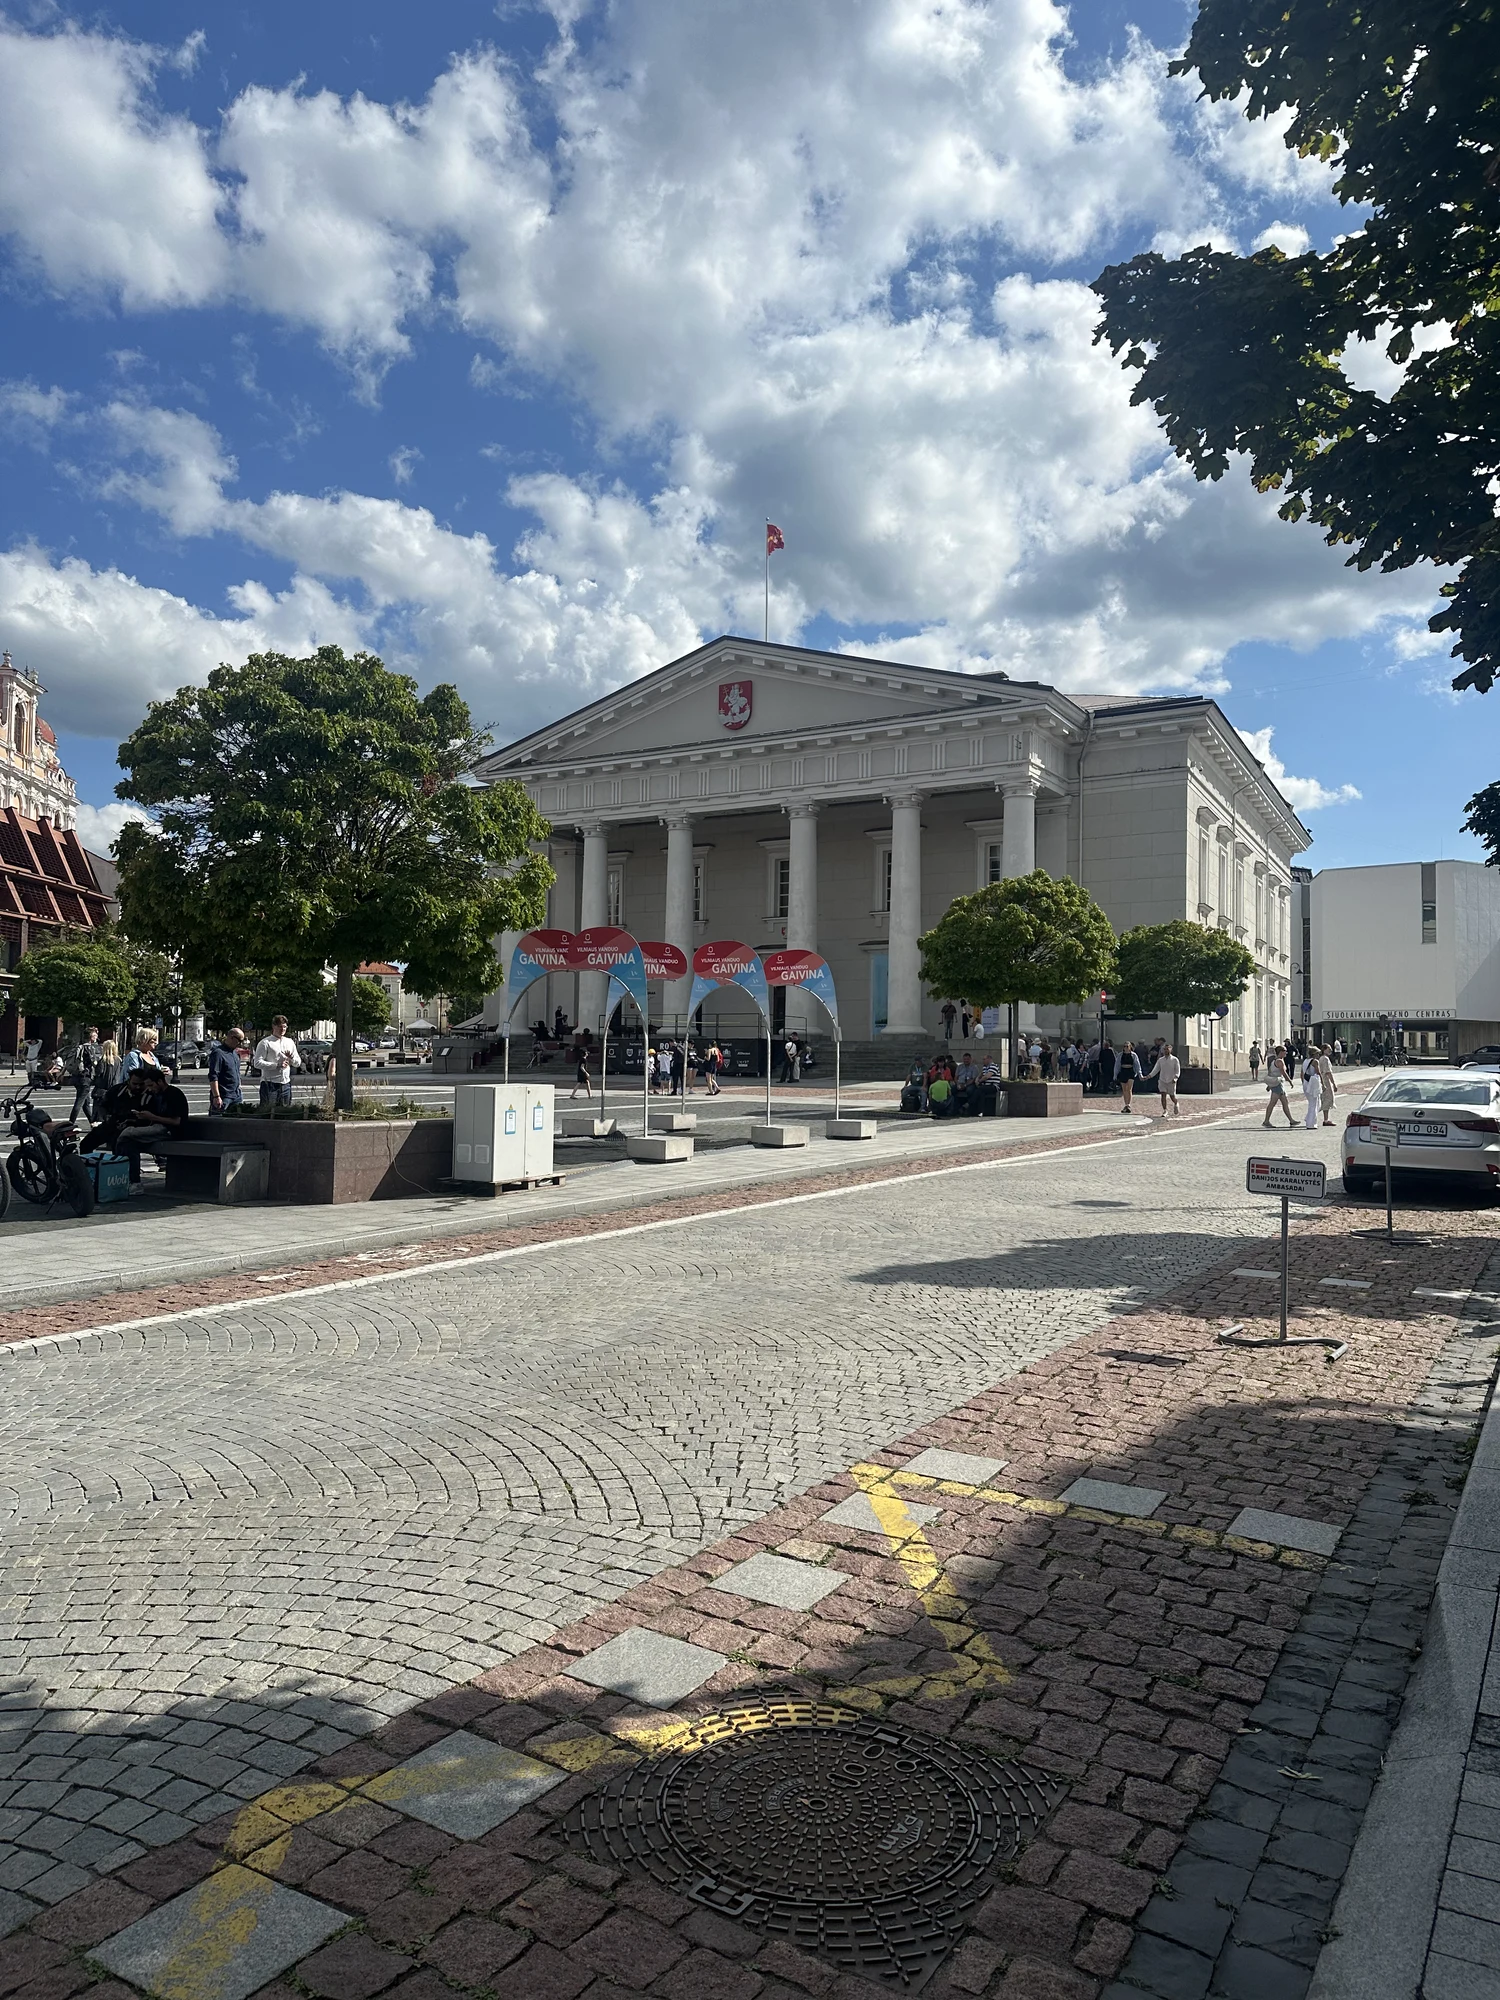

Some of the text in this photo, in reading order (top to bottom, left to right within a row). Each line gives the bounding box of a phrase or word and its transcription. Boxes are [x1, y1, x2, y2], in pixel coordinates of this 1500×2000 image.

[519, 953, 567, 965] GAIVINA
[587, 952, 636, 965] GAIVINA
[712, 963, 756, 974] GAIVINA
[781, 969, 825, 980] GAIVINA
[1387, 1010, 1409, 1018] MENO
[1416, 1010, 1451, 1018] CENTRAS
[1426, 1125, 1445, 1134] 094
[1270, 1167, 1322, 1178] REZERVUOTA
[1251, 1174, 1321, 1186] DANIJOS KARALYSTĖS
[1266, 1183, 1305, 1192] AMBASADAI
[876, 1814, 918, 1851] PAM
